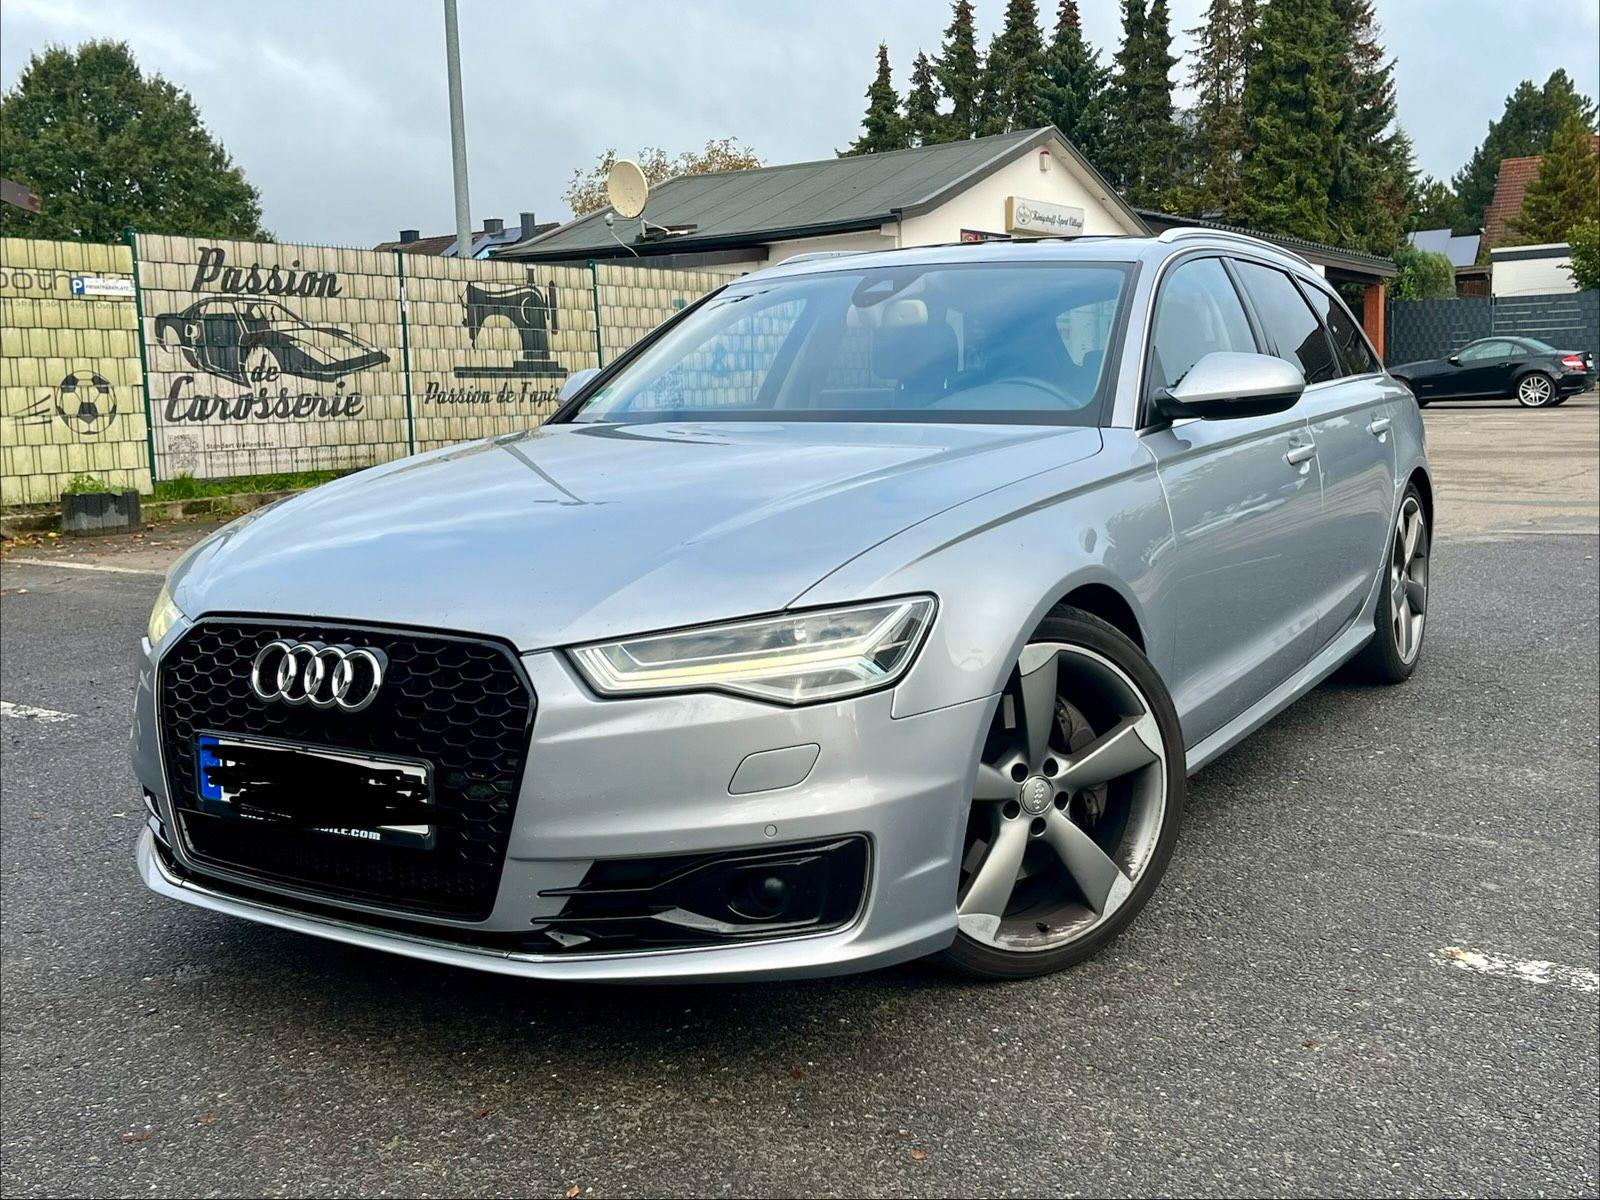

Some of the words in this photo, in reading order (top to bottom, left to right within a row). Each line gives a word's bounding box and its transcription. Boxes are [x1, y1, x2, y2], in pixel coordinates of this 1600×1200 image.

[191, 247, 342, 297] Passion
[250, 354, 280, 383] de
[164, 375, 365, 423] Carosserie
[425, 381, 493, 404] Passion
[496, 382, 515, 403] de
